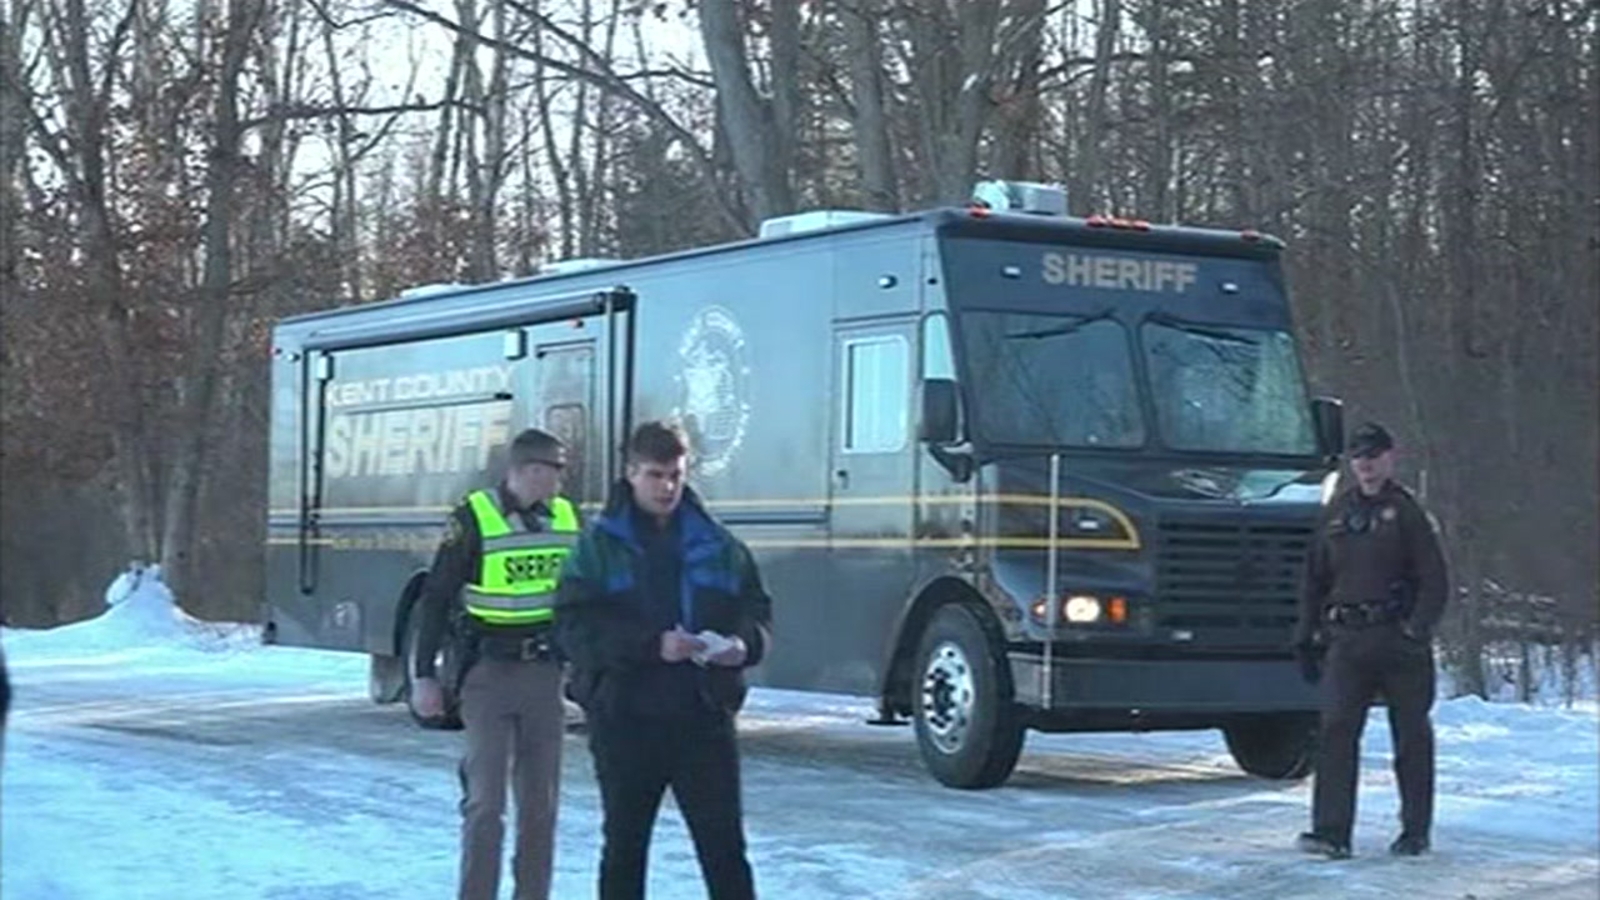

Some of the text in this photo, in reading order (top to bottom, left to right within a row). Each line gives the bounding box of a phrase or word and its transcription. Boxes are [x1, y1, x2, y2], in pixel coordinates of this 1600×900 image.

[1041, 252, 1197, 294] SHERIFF
[325, 364, 513, 407] KENT COUNTY
[325, 402, 513, 478] SHERIFF
[504, 552, 563, 585] SHERIF
